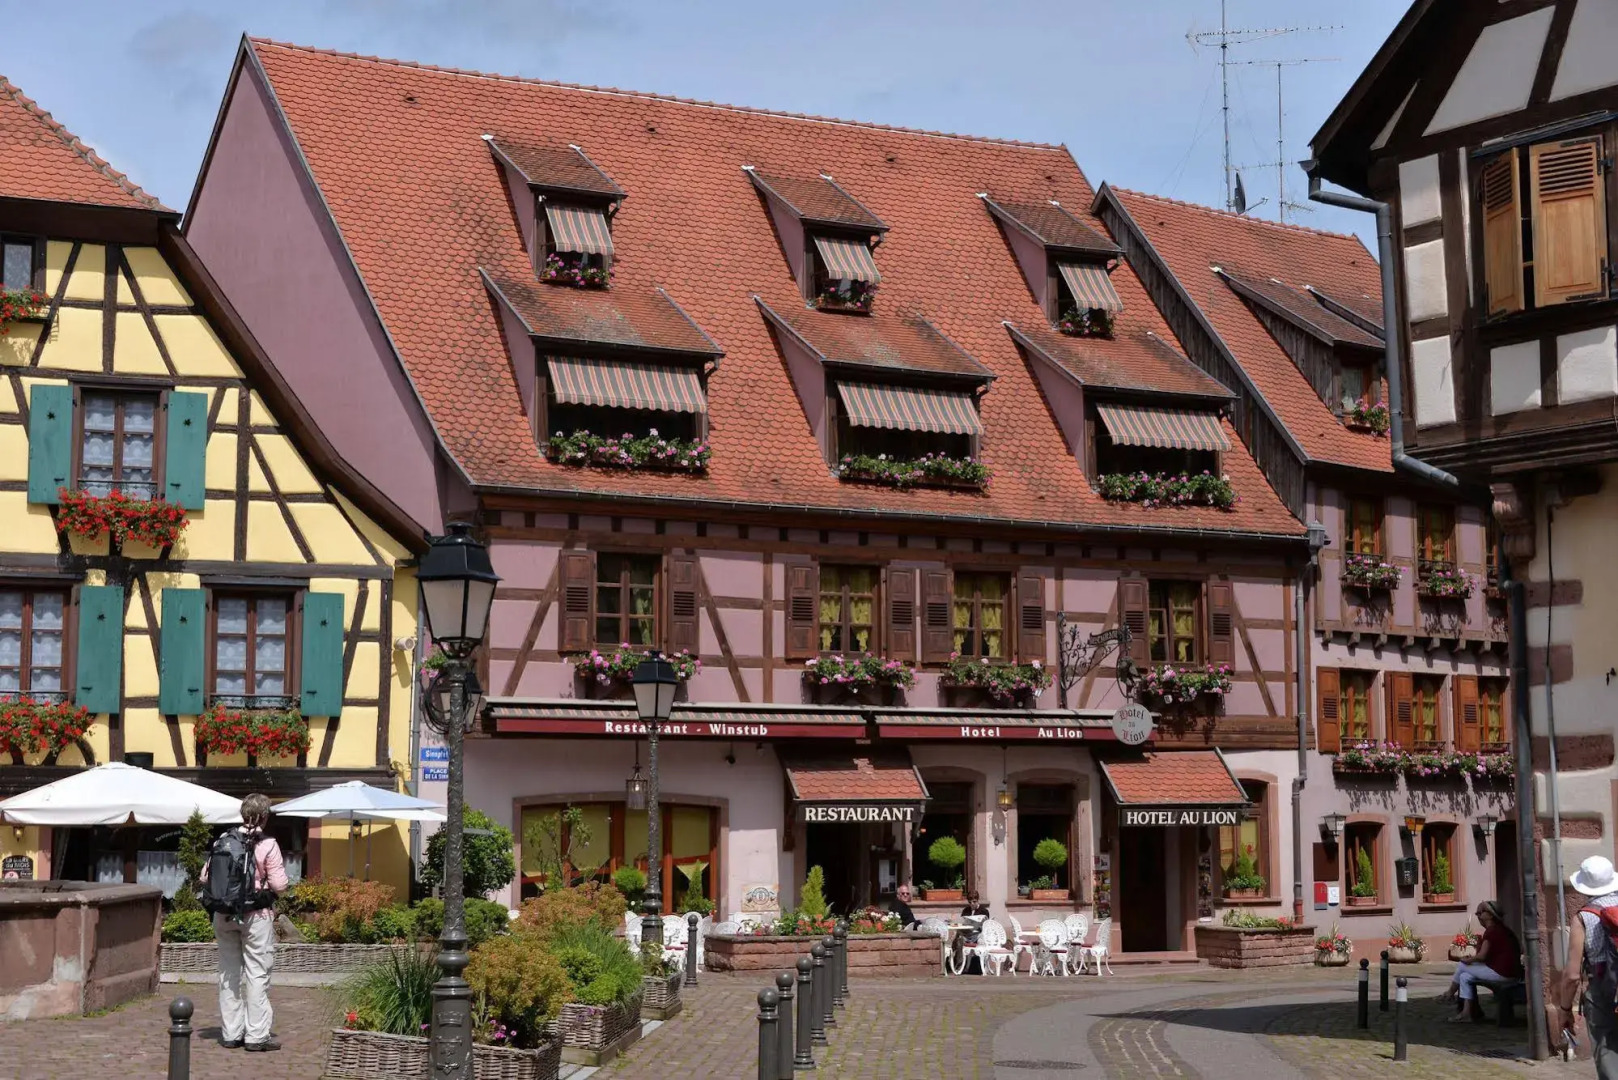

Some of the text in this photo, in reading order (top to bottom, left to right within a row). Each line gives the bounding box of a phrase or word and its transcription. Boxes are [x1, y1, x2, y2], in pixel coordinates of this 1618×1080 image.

[709, 723, 768, 736] Winstub
[960, 726, 1001, 738] Hotel
[1037, 727, 1083, 738] Au Lion
[804, 807, 915, 821] RESTAURANT
[1126, 811, 1237, 825] HOTEL AU LION
